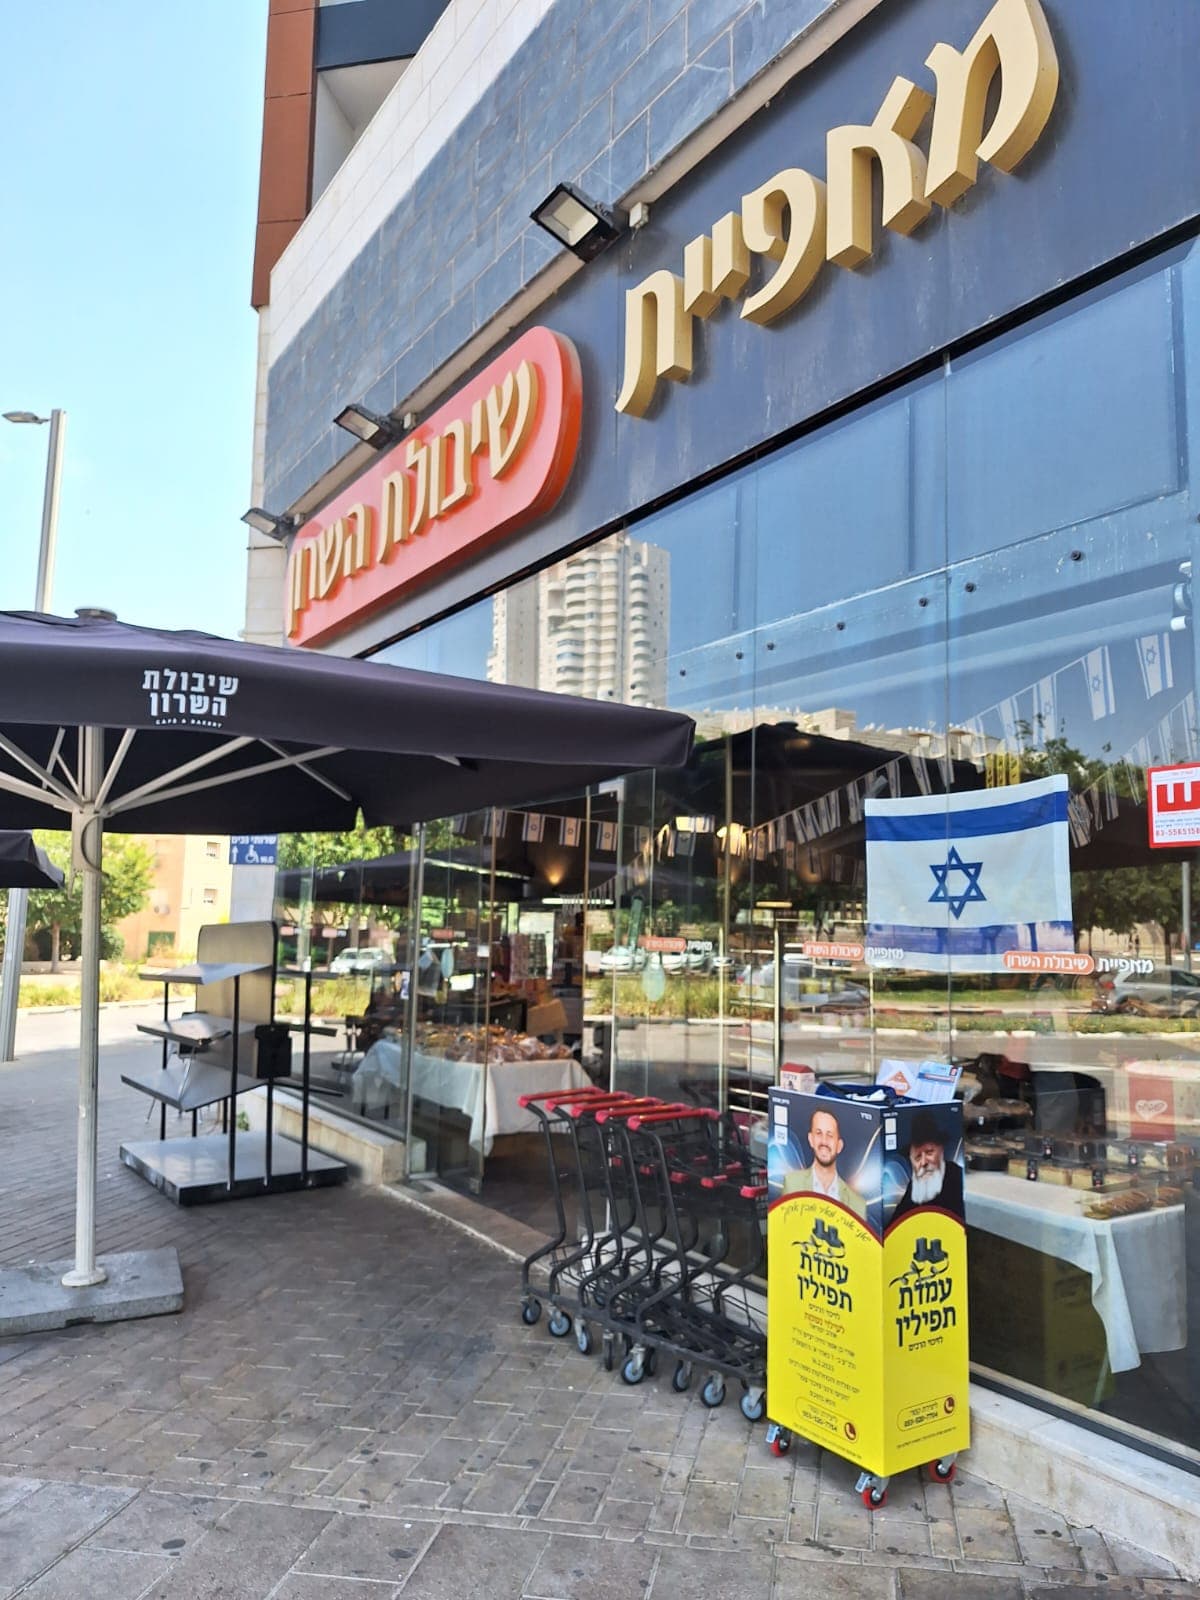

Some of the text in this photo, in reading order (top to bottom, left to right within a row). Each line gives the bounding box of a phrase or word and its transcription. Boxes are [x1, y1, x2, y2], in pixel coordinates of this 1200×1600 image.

[614, 0, 1058, 420] מאפיית
[287, 359, 538, 638] שיבולת השרון
[142, 668, 239, 695] שיבולת
[150, 692, 227, 717] השרון
[830, 943, 861, 957] שיבולת
[1007, 954, 1154, 973] מאפיית שיבולת השרון
[800, 1251, 849, 1285] עמדת
[797, 1274, 853, 1312] תפילין
[899, 1277, 952, 1309] עמדת
[896, 1306, 956, 1347] תפילין
